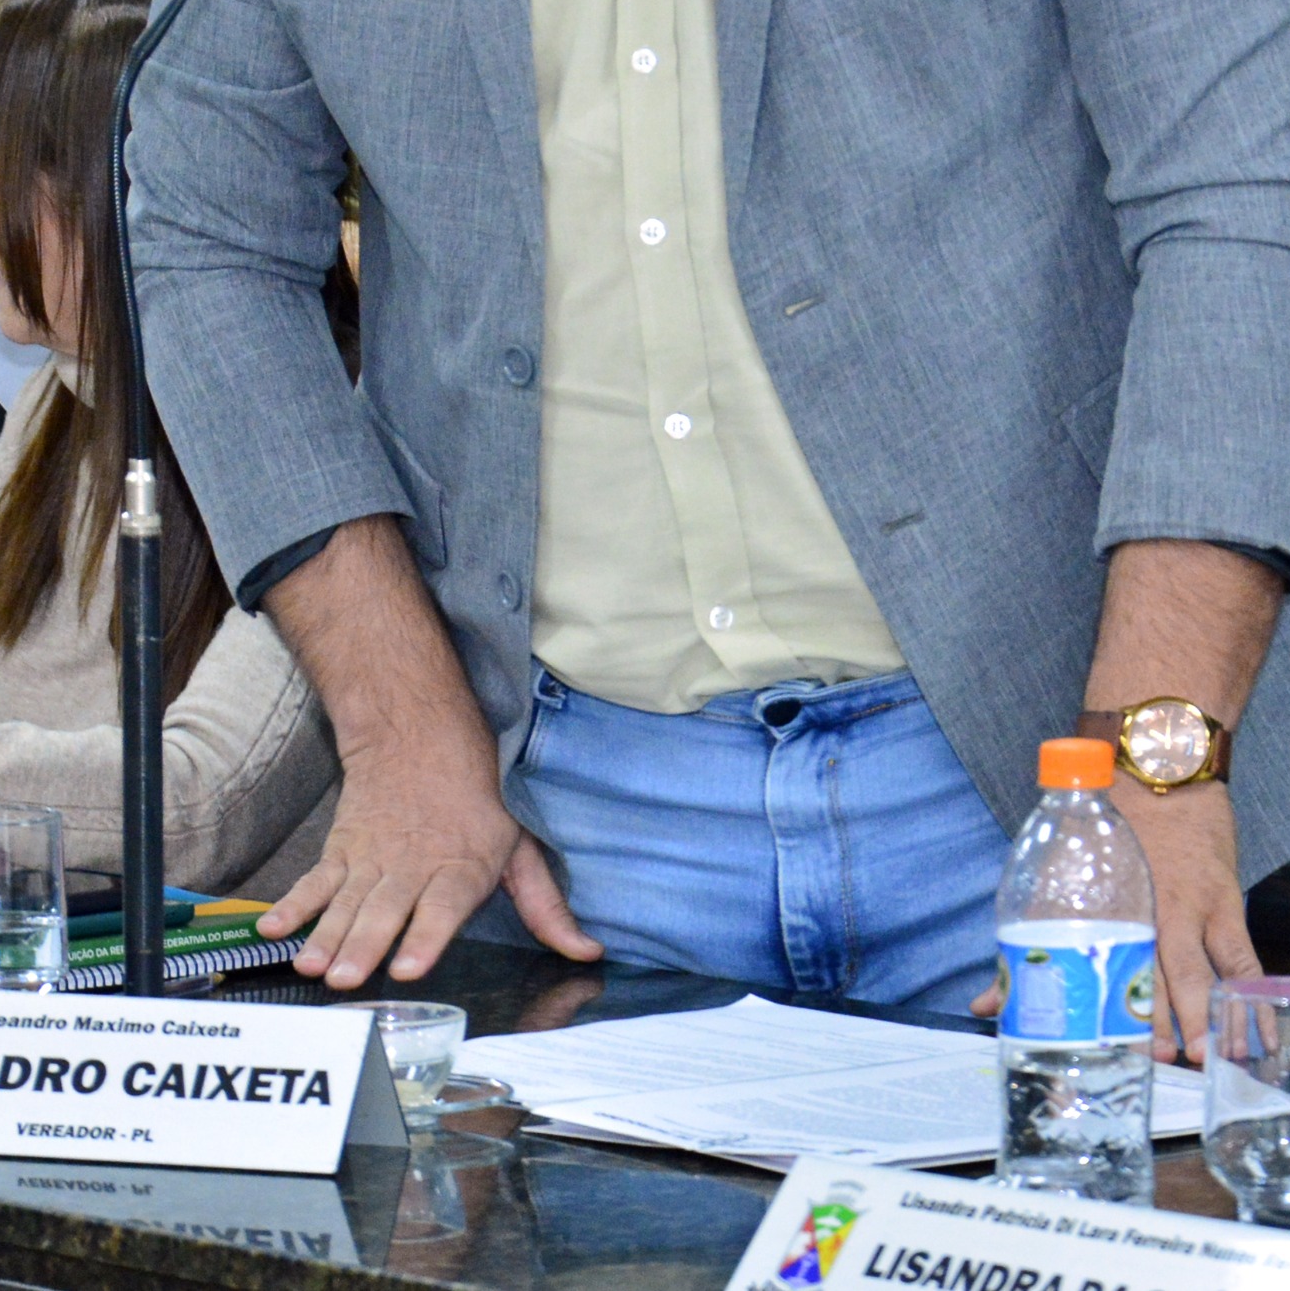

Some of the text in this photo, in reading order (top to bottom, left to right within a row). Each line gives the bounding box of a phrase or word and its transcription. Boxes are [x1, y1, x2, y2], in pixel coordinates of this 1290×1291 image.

[68, 948, 94, 961] UIÇÃO
[163, 934, 207, 949] EDERATIVA
[208, 932, 221, 942] DO
[223, 928, 251, 941] BRASIL
[73, 1016, 155, 1035] Maximo
[162, 1020, 241, 1039] Caixeta
[122, 1061, 332, 1106] CAIXETA
[16, 1122, 116, 1141] VEREADOR
[131, 1128, 154, 1143] PL
[900, 1191, 976, 1218] Lisandra
[1078, 1220, 1119, 1242] Lara
[1122, 1228, 1195, 1256] Ferreira
